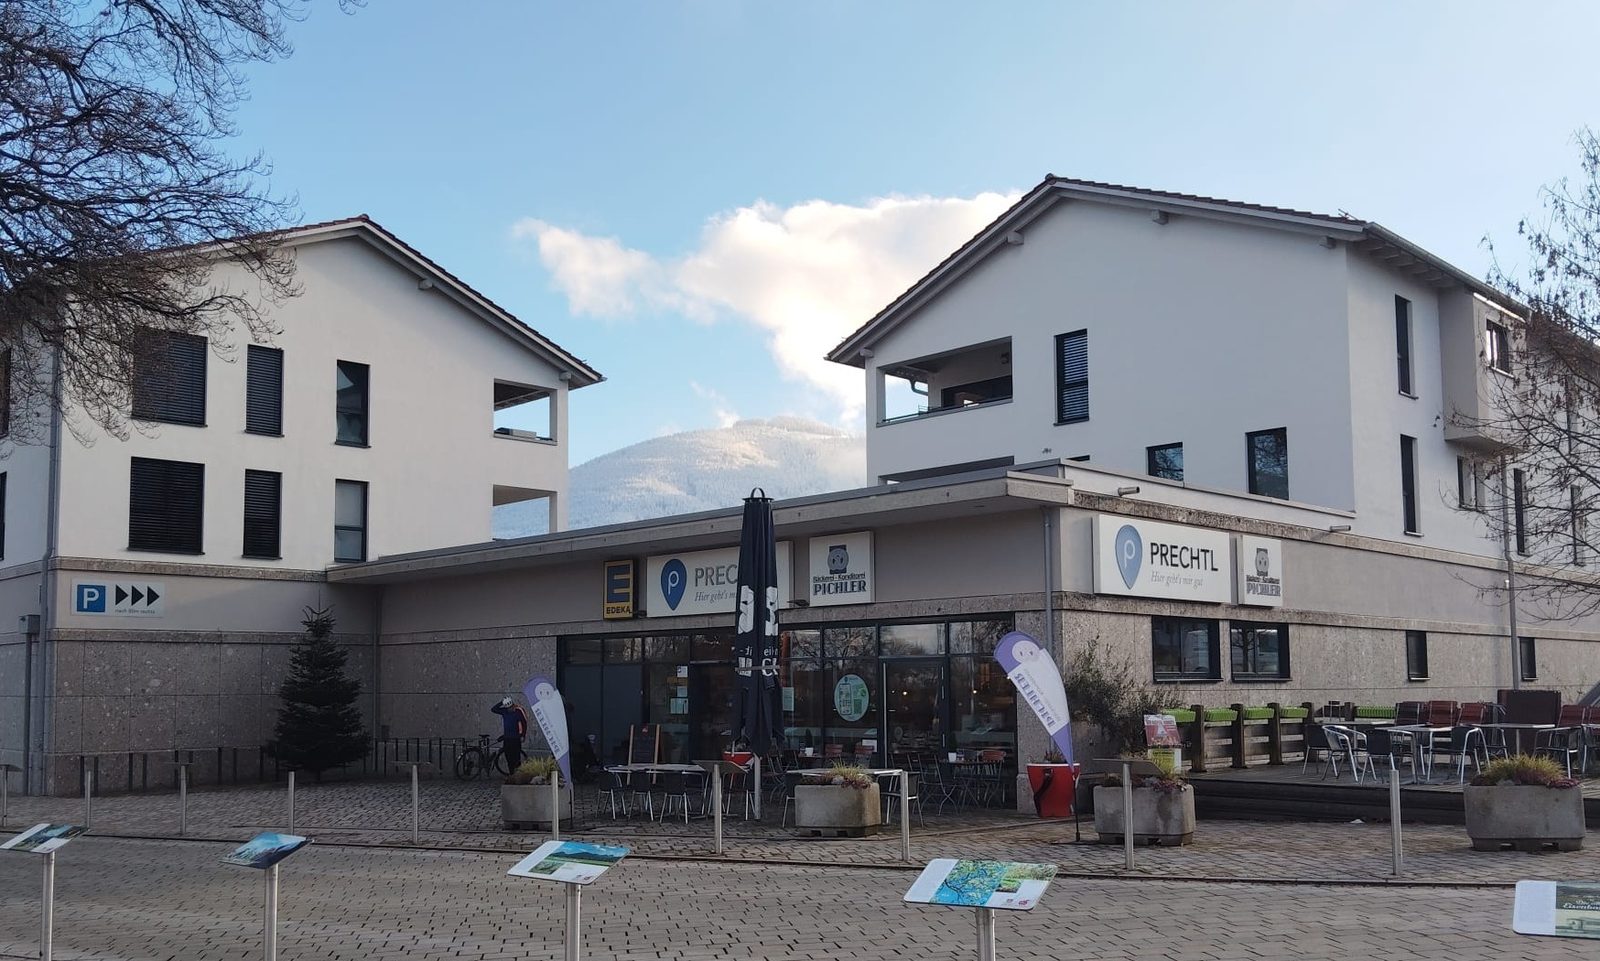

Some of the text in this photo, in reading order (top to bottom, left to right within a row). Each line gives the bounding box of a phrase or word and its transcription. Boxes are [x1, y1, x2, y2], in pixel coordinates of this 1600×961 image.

[1150, 542, 1219, 572] PRECHTL
[694, 564, 738, 587] PREC
[1151, 570, 1166, 583] Hier
[812, 580, 867, 596] PICHLER
[83, 587, 100, 609] P
[694, 591, 710, 602] Hier
[710, 589, 729, 604] geht's
[606, 606, 631, 615] EDEKA
